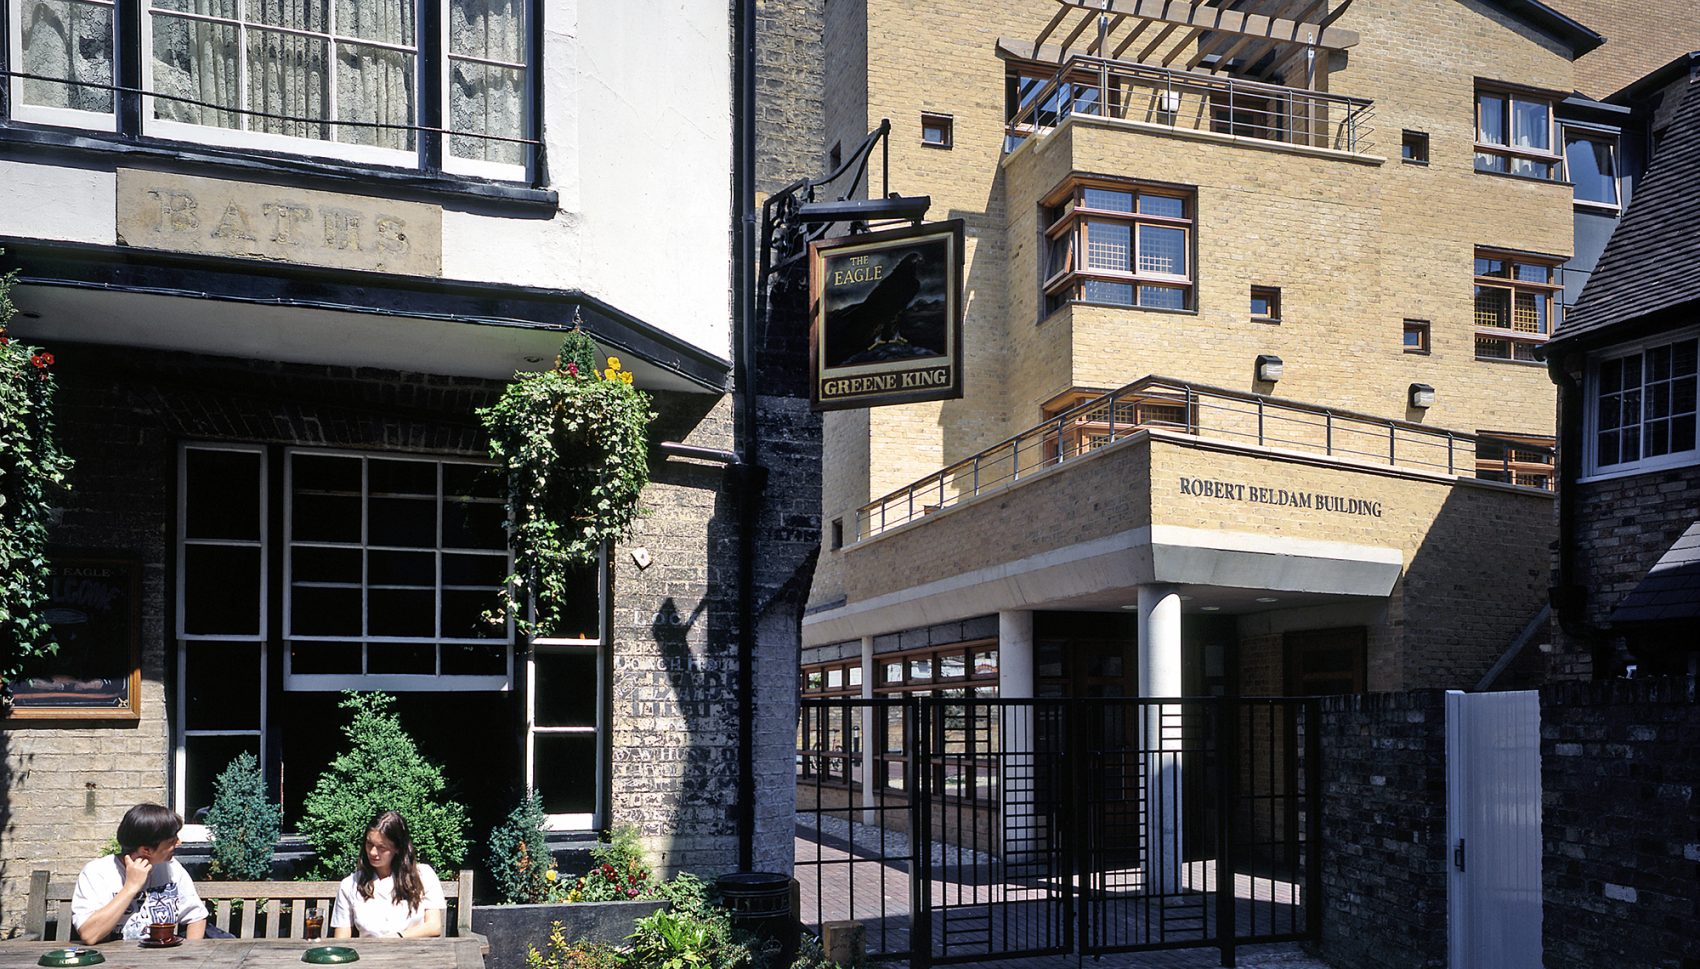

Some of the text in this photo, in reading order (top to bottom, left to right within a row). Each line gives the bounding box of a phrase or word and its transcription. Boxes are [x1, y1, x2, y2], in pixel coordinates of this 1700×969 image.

[148, 187, 409, 256] BATHS
[849, 255, 869, 266] THE
[834, 265, 883, 286] EAGLE
[824, 369, 947, 395] GREENE KING
[1179, 477, 1382, 518] ROBERT BELDAM BUILDING
